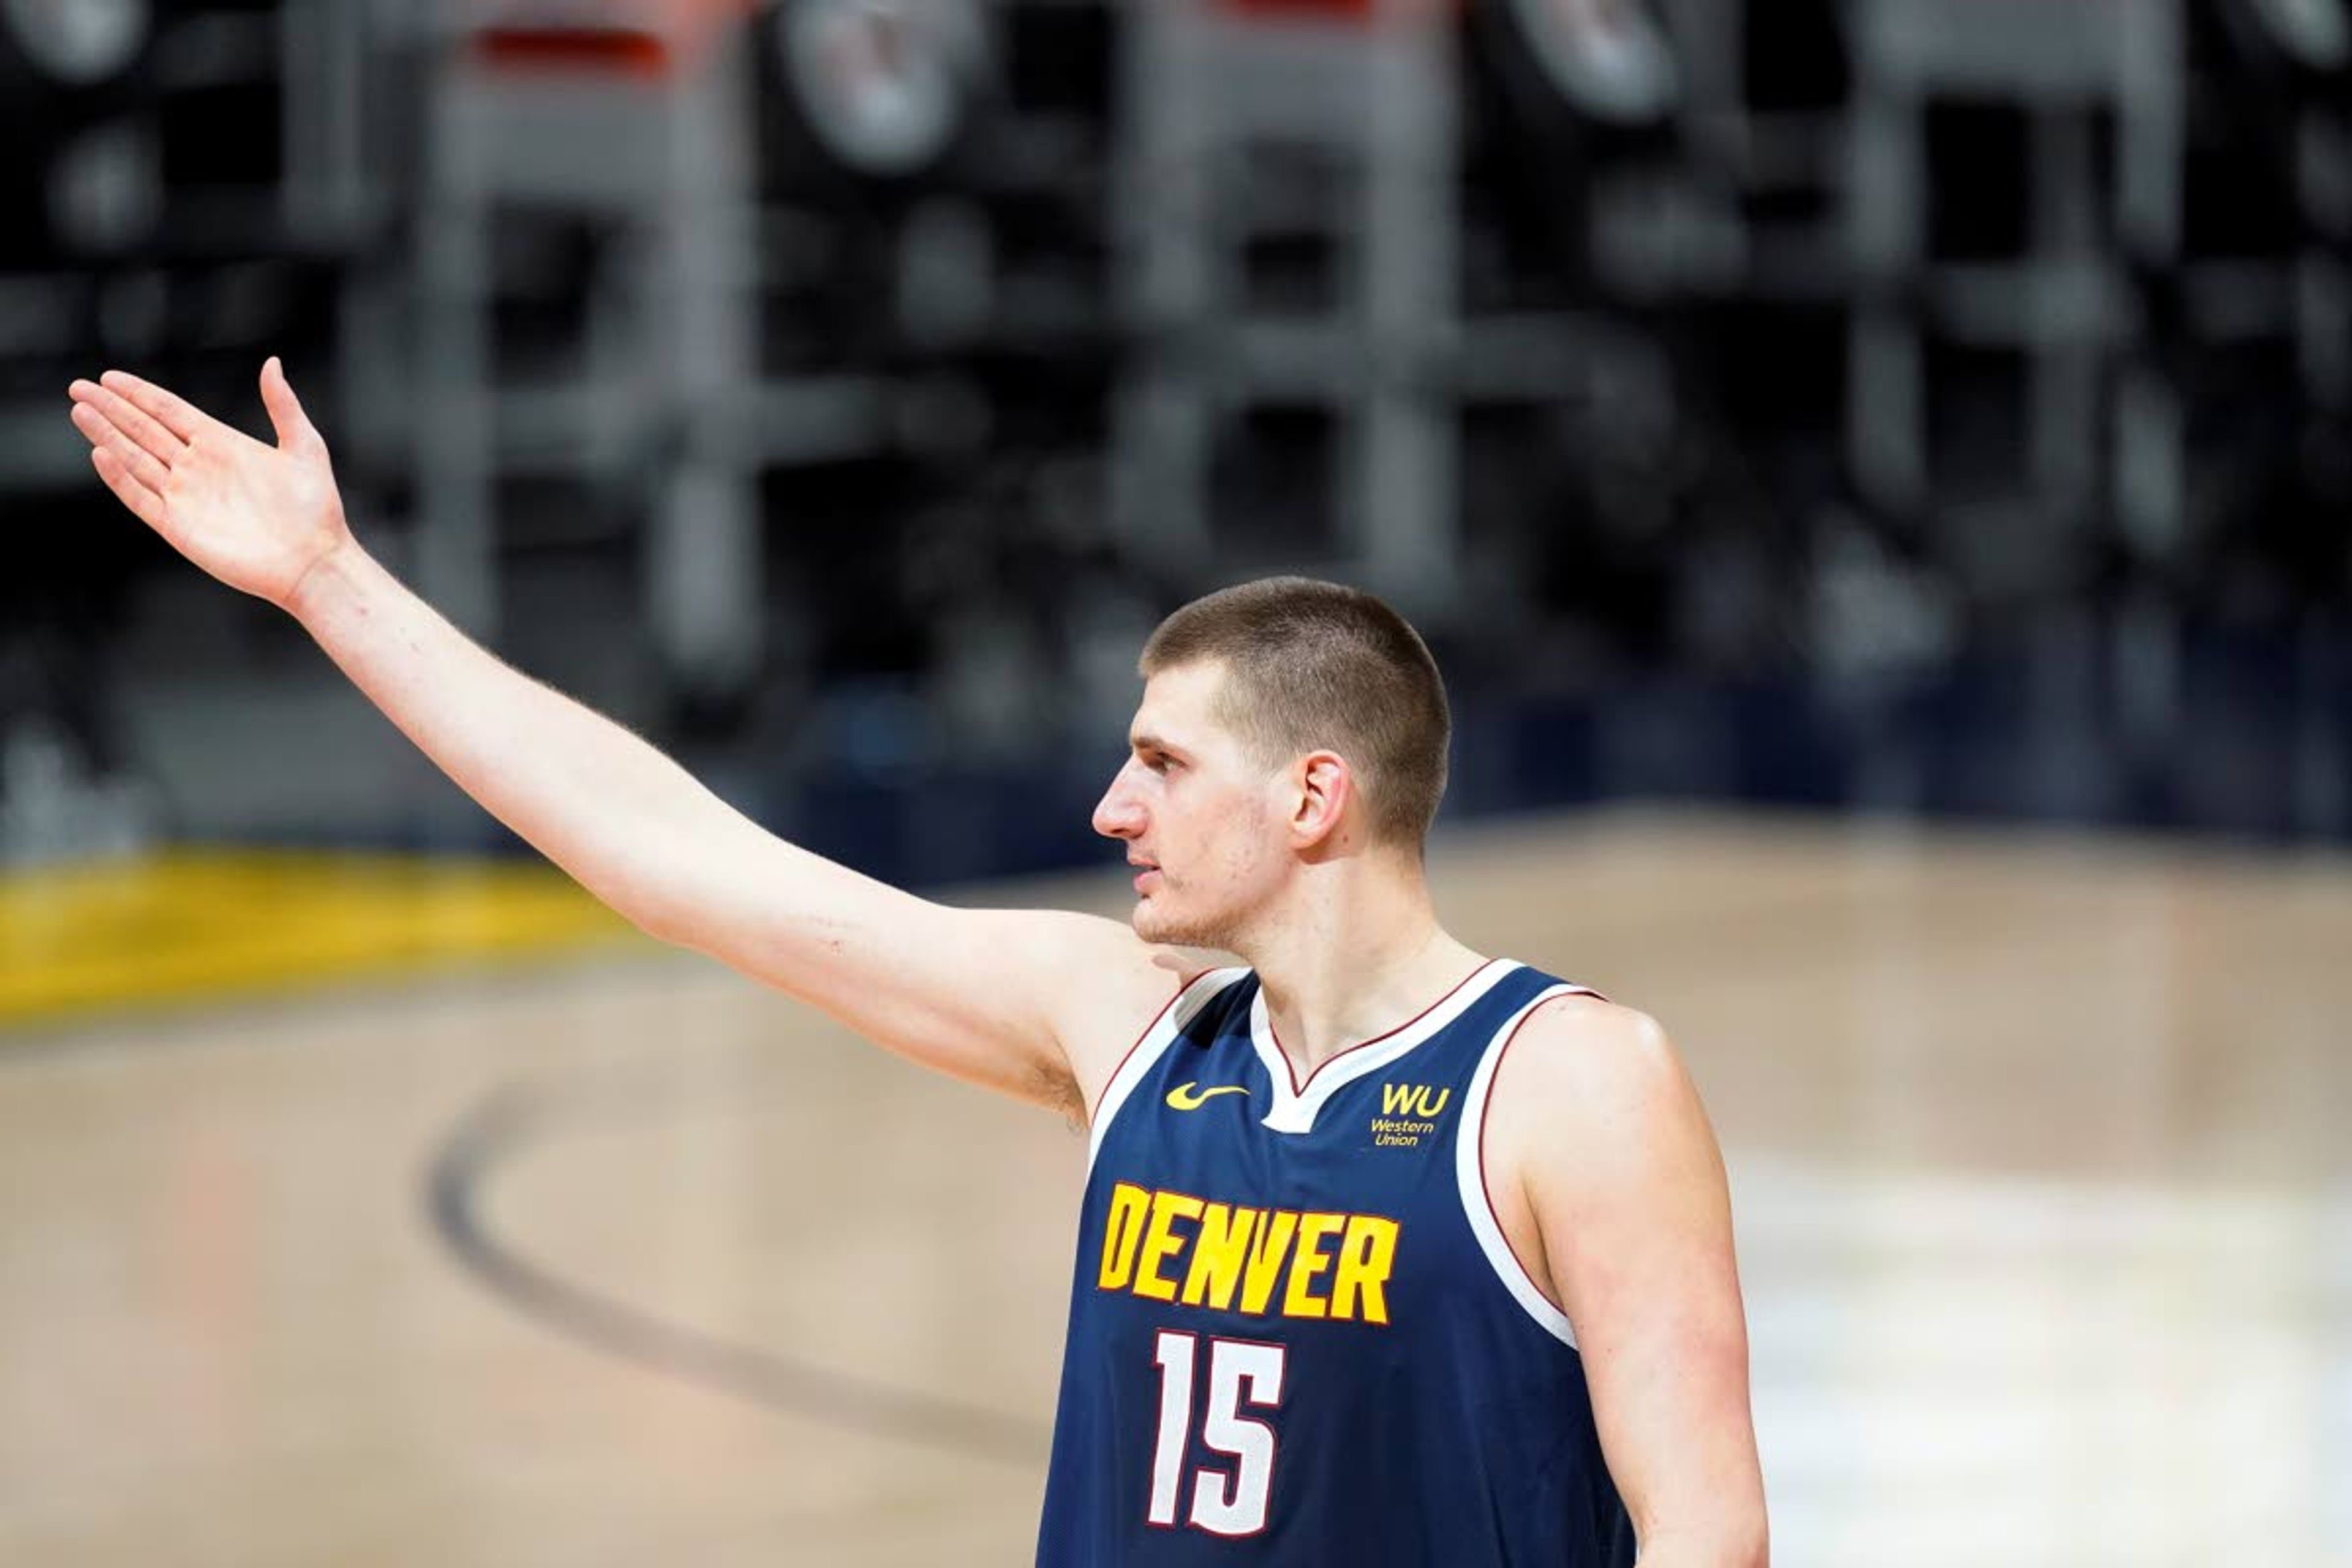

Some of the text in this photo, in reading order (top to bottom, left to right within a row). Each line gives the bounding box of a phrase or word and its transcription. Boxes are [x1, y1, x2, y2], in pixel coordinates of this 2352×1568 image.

[1382, 1083, 1450, 1118] WU
[1371, 1118, 1434, 1133] Western
[1375, 1133, 1419, 1146] Union
[1098, 1182, 1401, 1325] DENVER
[1145, 1327, 1286, 1540] 15
